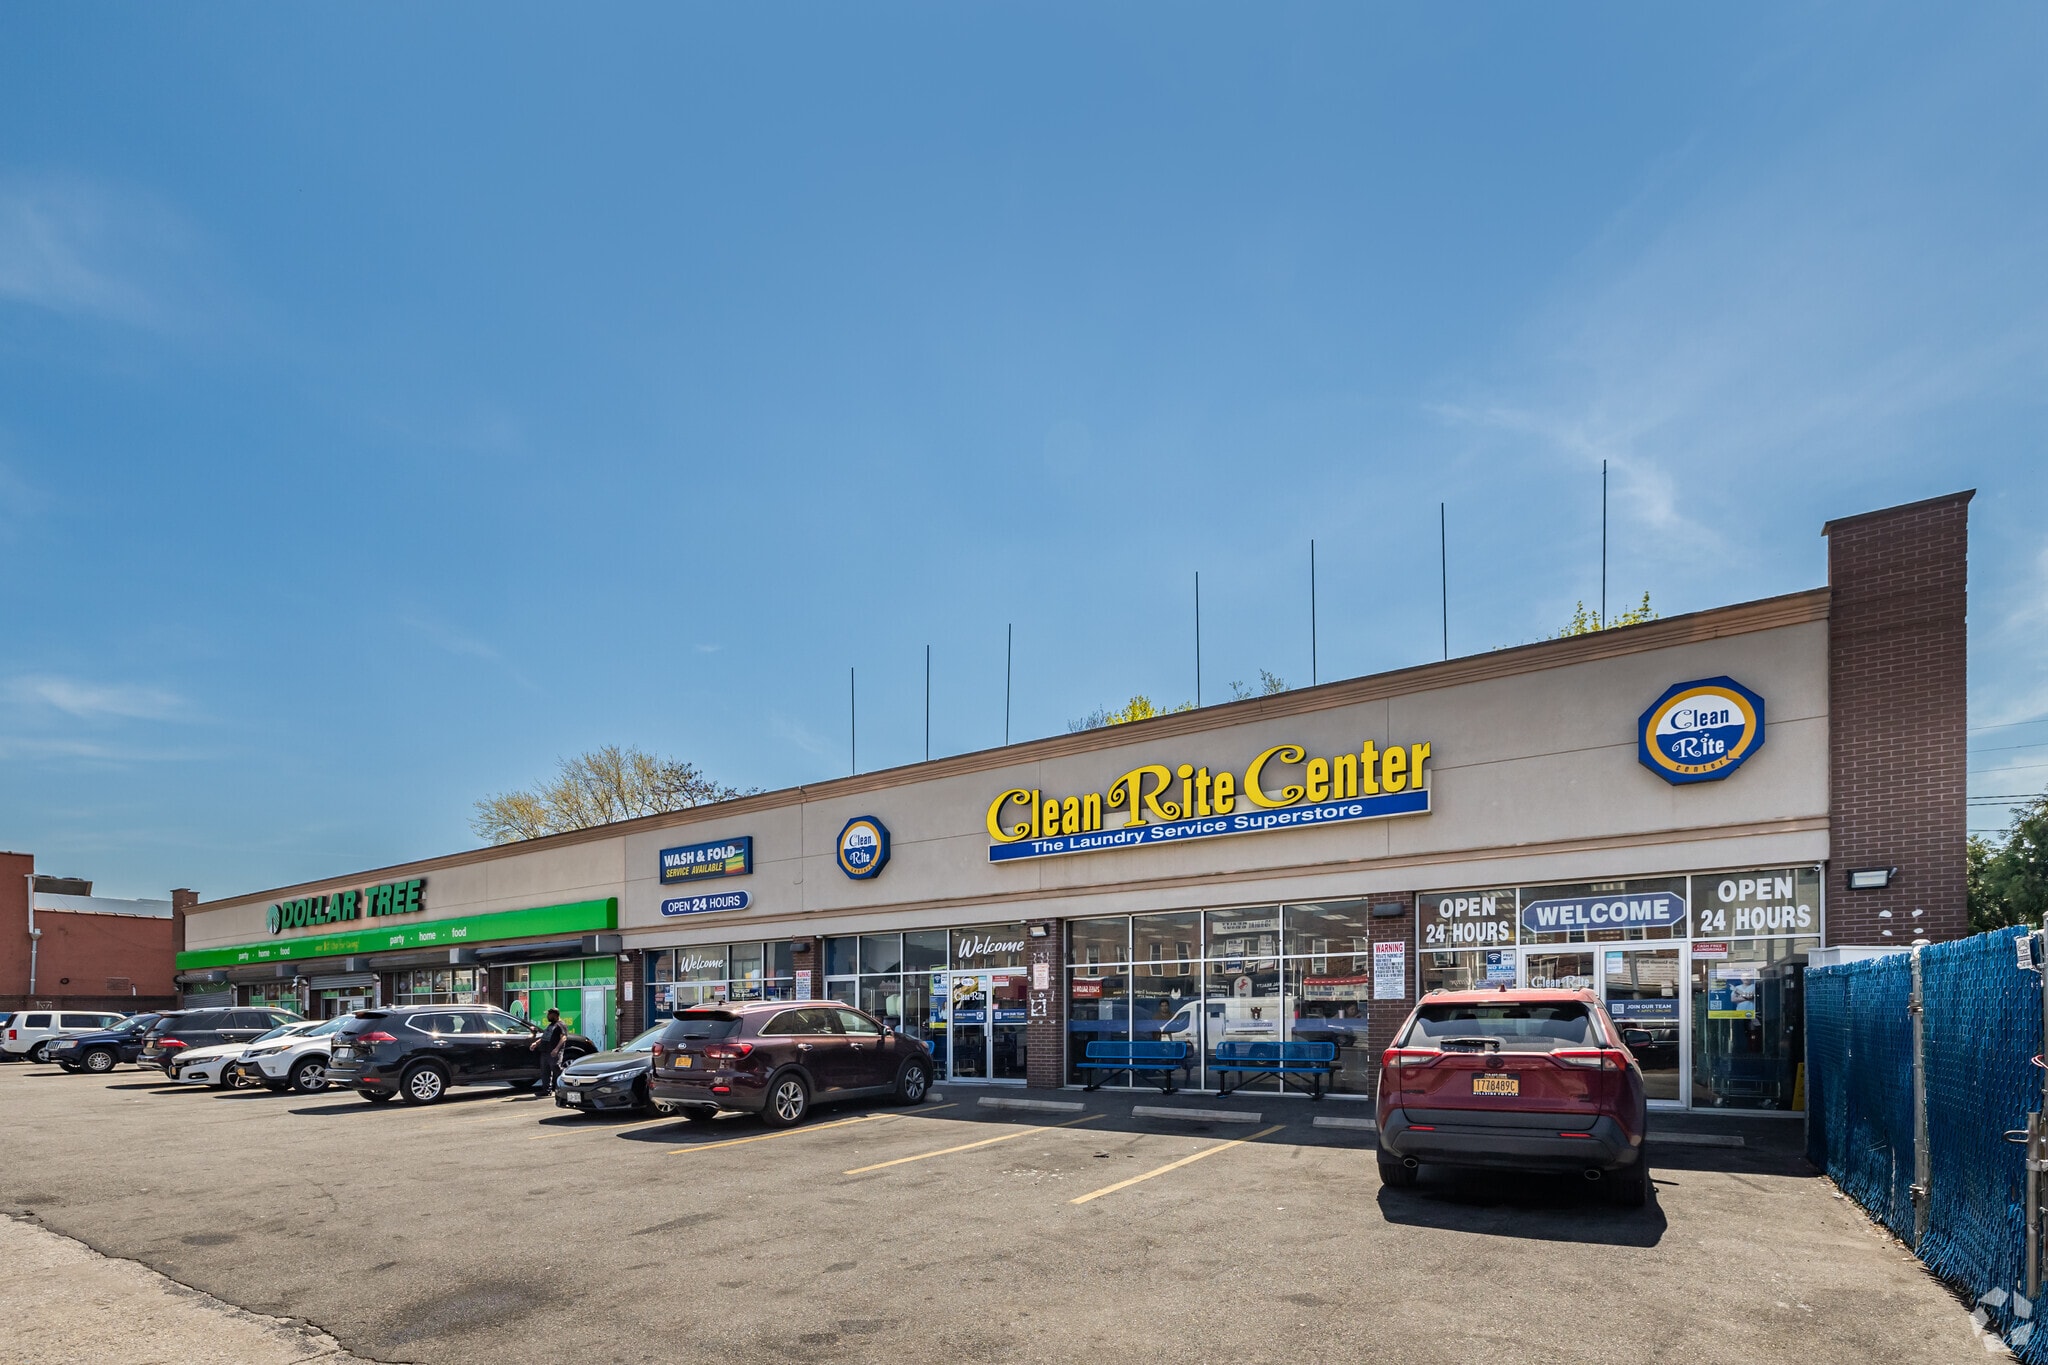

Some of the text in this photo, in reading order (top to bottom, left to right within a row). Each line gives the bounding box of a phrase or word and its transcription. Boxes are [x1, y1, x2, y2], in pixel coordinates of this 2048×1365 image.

[1670, 709, 1729, 730] Clean
[1672, 733, 1724, 758] Rite
[1676, 760, 1724, 772] center
[986, 740, 1431, 843] Clean Rite Center
[1032, 802, 1362, 854] The Laundry Service Superstore
[849, 834, 872, 847] Clean
[664, 846, 736, 867] WASH & FOLD
[850, 850, 870, 864] Rite
[666, 862, 724, 878] SERVICE AVAILABLE
[1718, 876, 1793, 902] OPEN
[281, 879, 422, 930] DOLLAR TREE
[668, 896, 740, 912] OPEN 24 HOURS
[1439, 896, 1496, 919] OPEN
[1536, 898, 1670, 927] WELCOME
[1700, 904, 1811, 932] 24 HOURS
[390, 927, 466, 946] party home food
[1426, 920, 1510, 944] 24 HOURS
[238, 946, 290, 961] party home food
[958, 934, 1025, 958] Welcome
[1376, 943, 1404, 953] WARNING
[680, 954, 724, 973] Welcome
[1530, 975, 1590, 988] Clean Rite
[1476, 1080, 1515, 1091] T778489C
